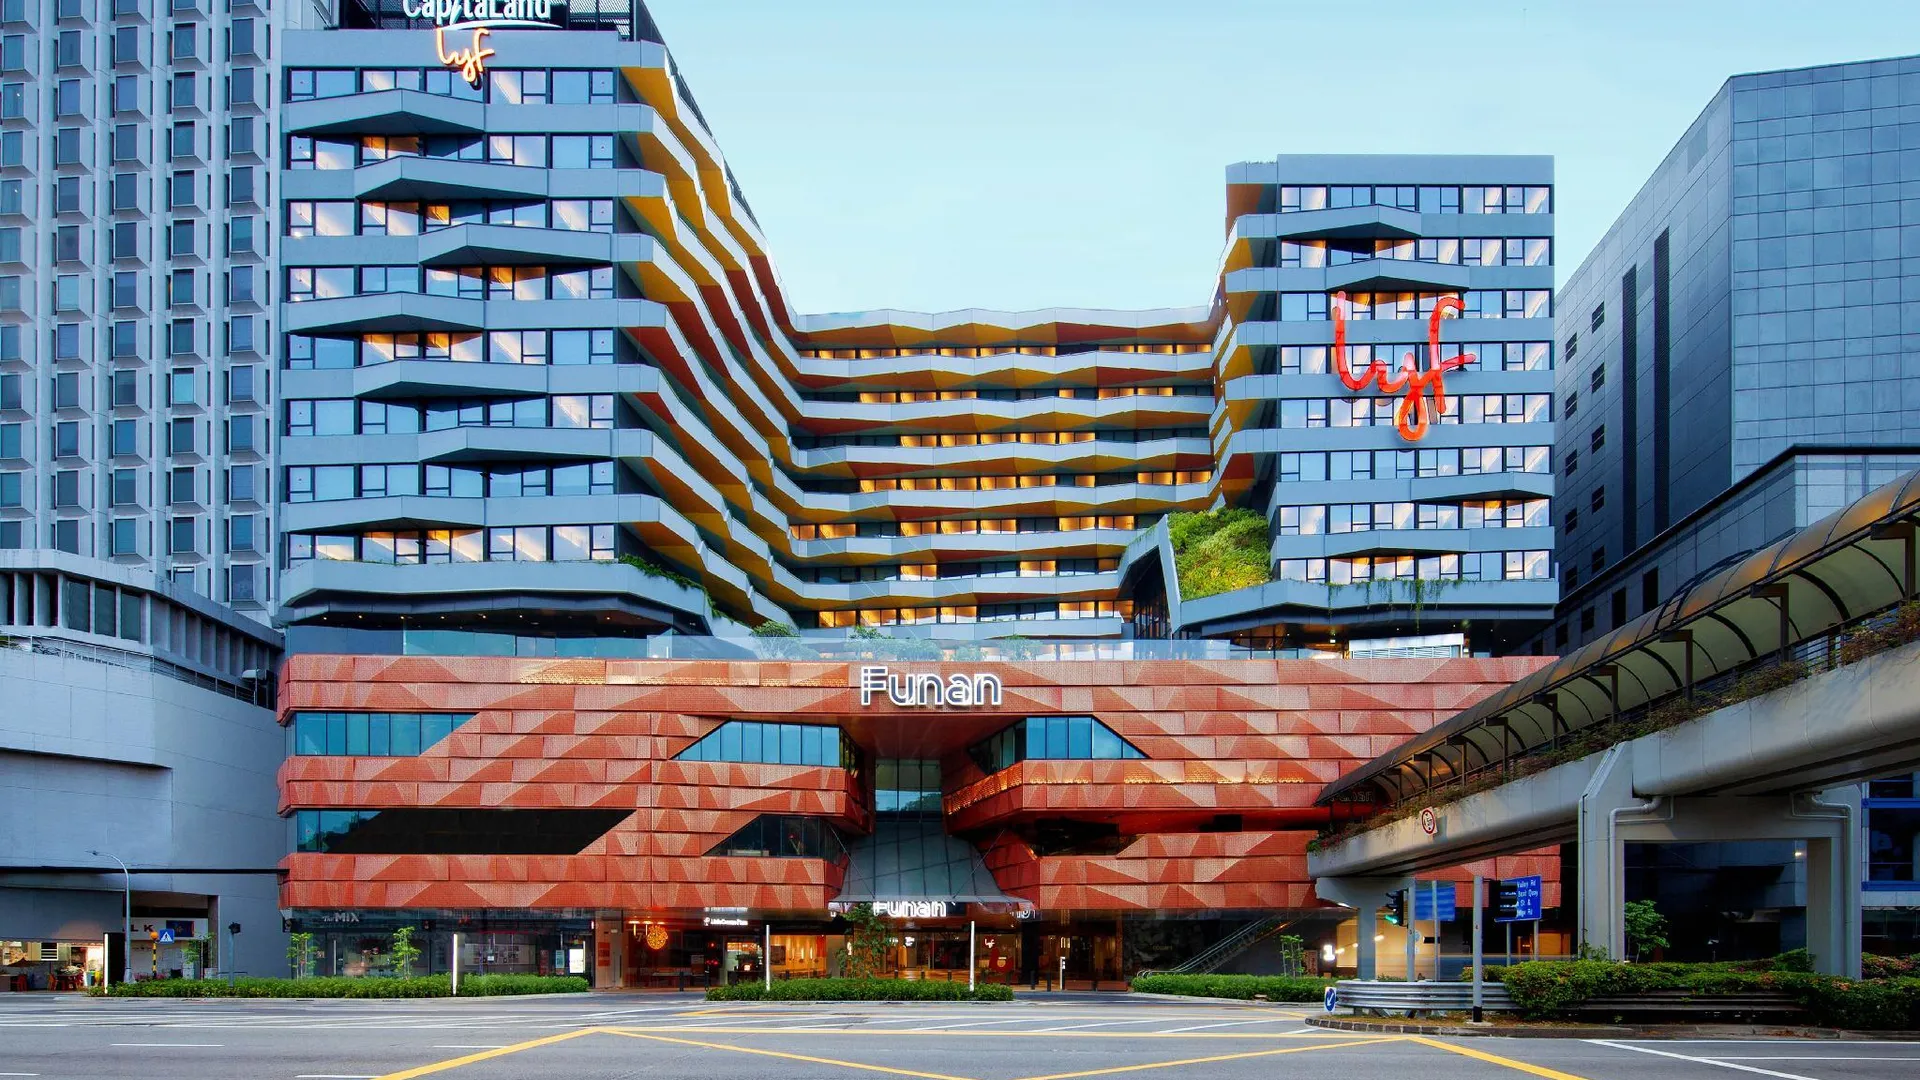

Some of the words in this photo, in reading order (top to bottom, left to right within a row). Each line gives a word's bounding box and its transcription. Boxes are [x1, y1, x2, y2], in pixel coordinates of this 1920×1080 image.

[403, 0, 551, 25] CapitaLand
[436, 27, 495, 82] lyf
[1332, 290, 1477, 441] lyf
[861, 666, 1002, 706] Funan
[872, 901, 947, 918] Funan
